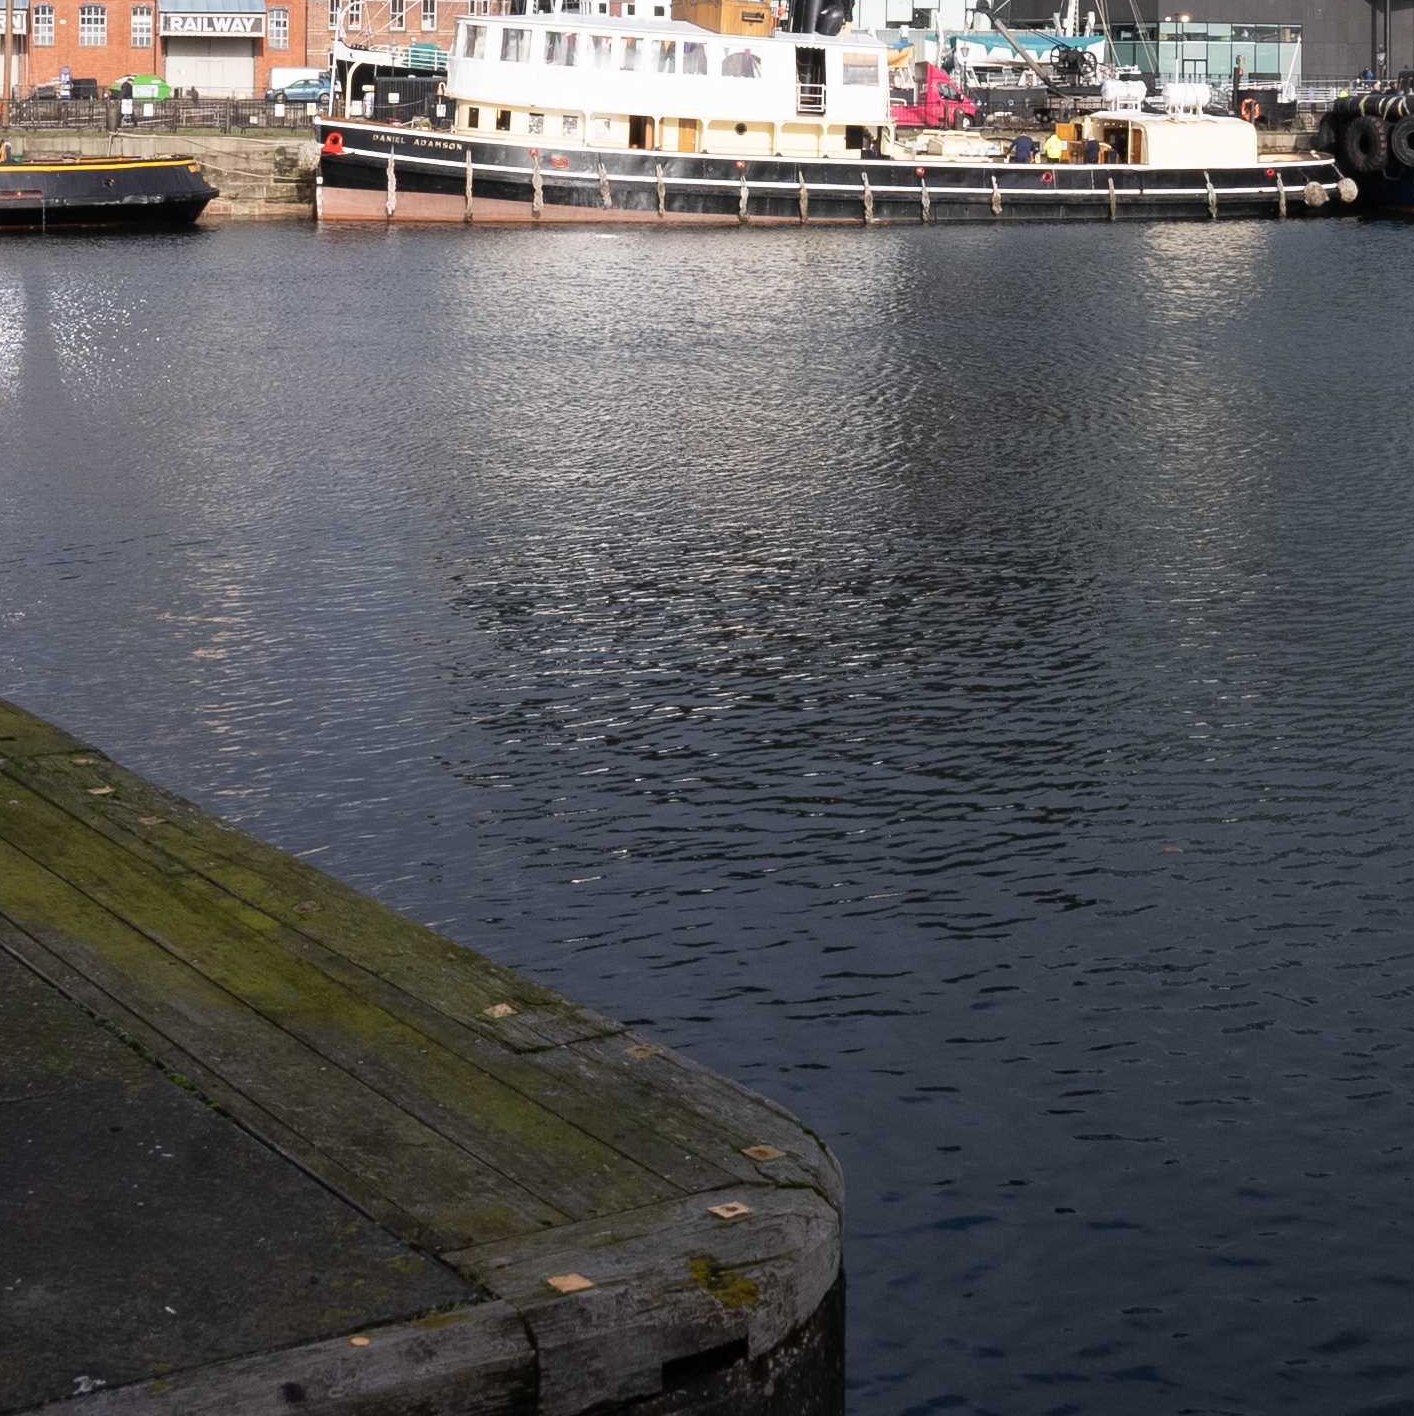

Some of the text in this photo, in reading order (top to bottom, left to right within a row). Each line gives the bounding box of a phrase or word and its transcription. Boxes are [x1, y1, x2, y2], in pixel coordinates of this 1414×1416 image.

[170, 17, 255, 32] RAILWAY
[372, 134, 462, 150] DANIEL ADAMSON
